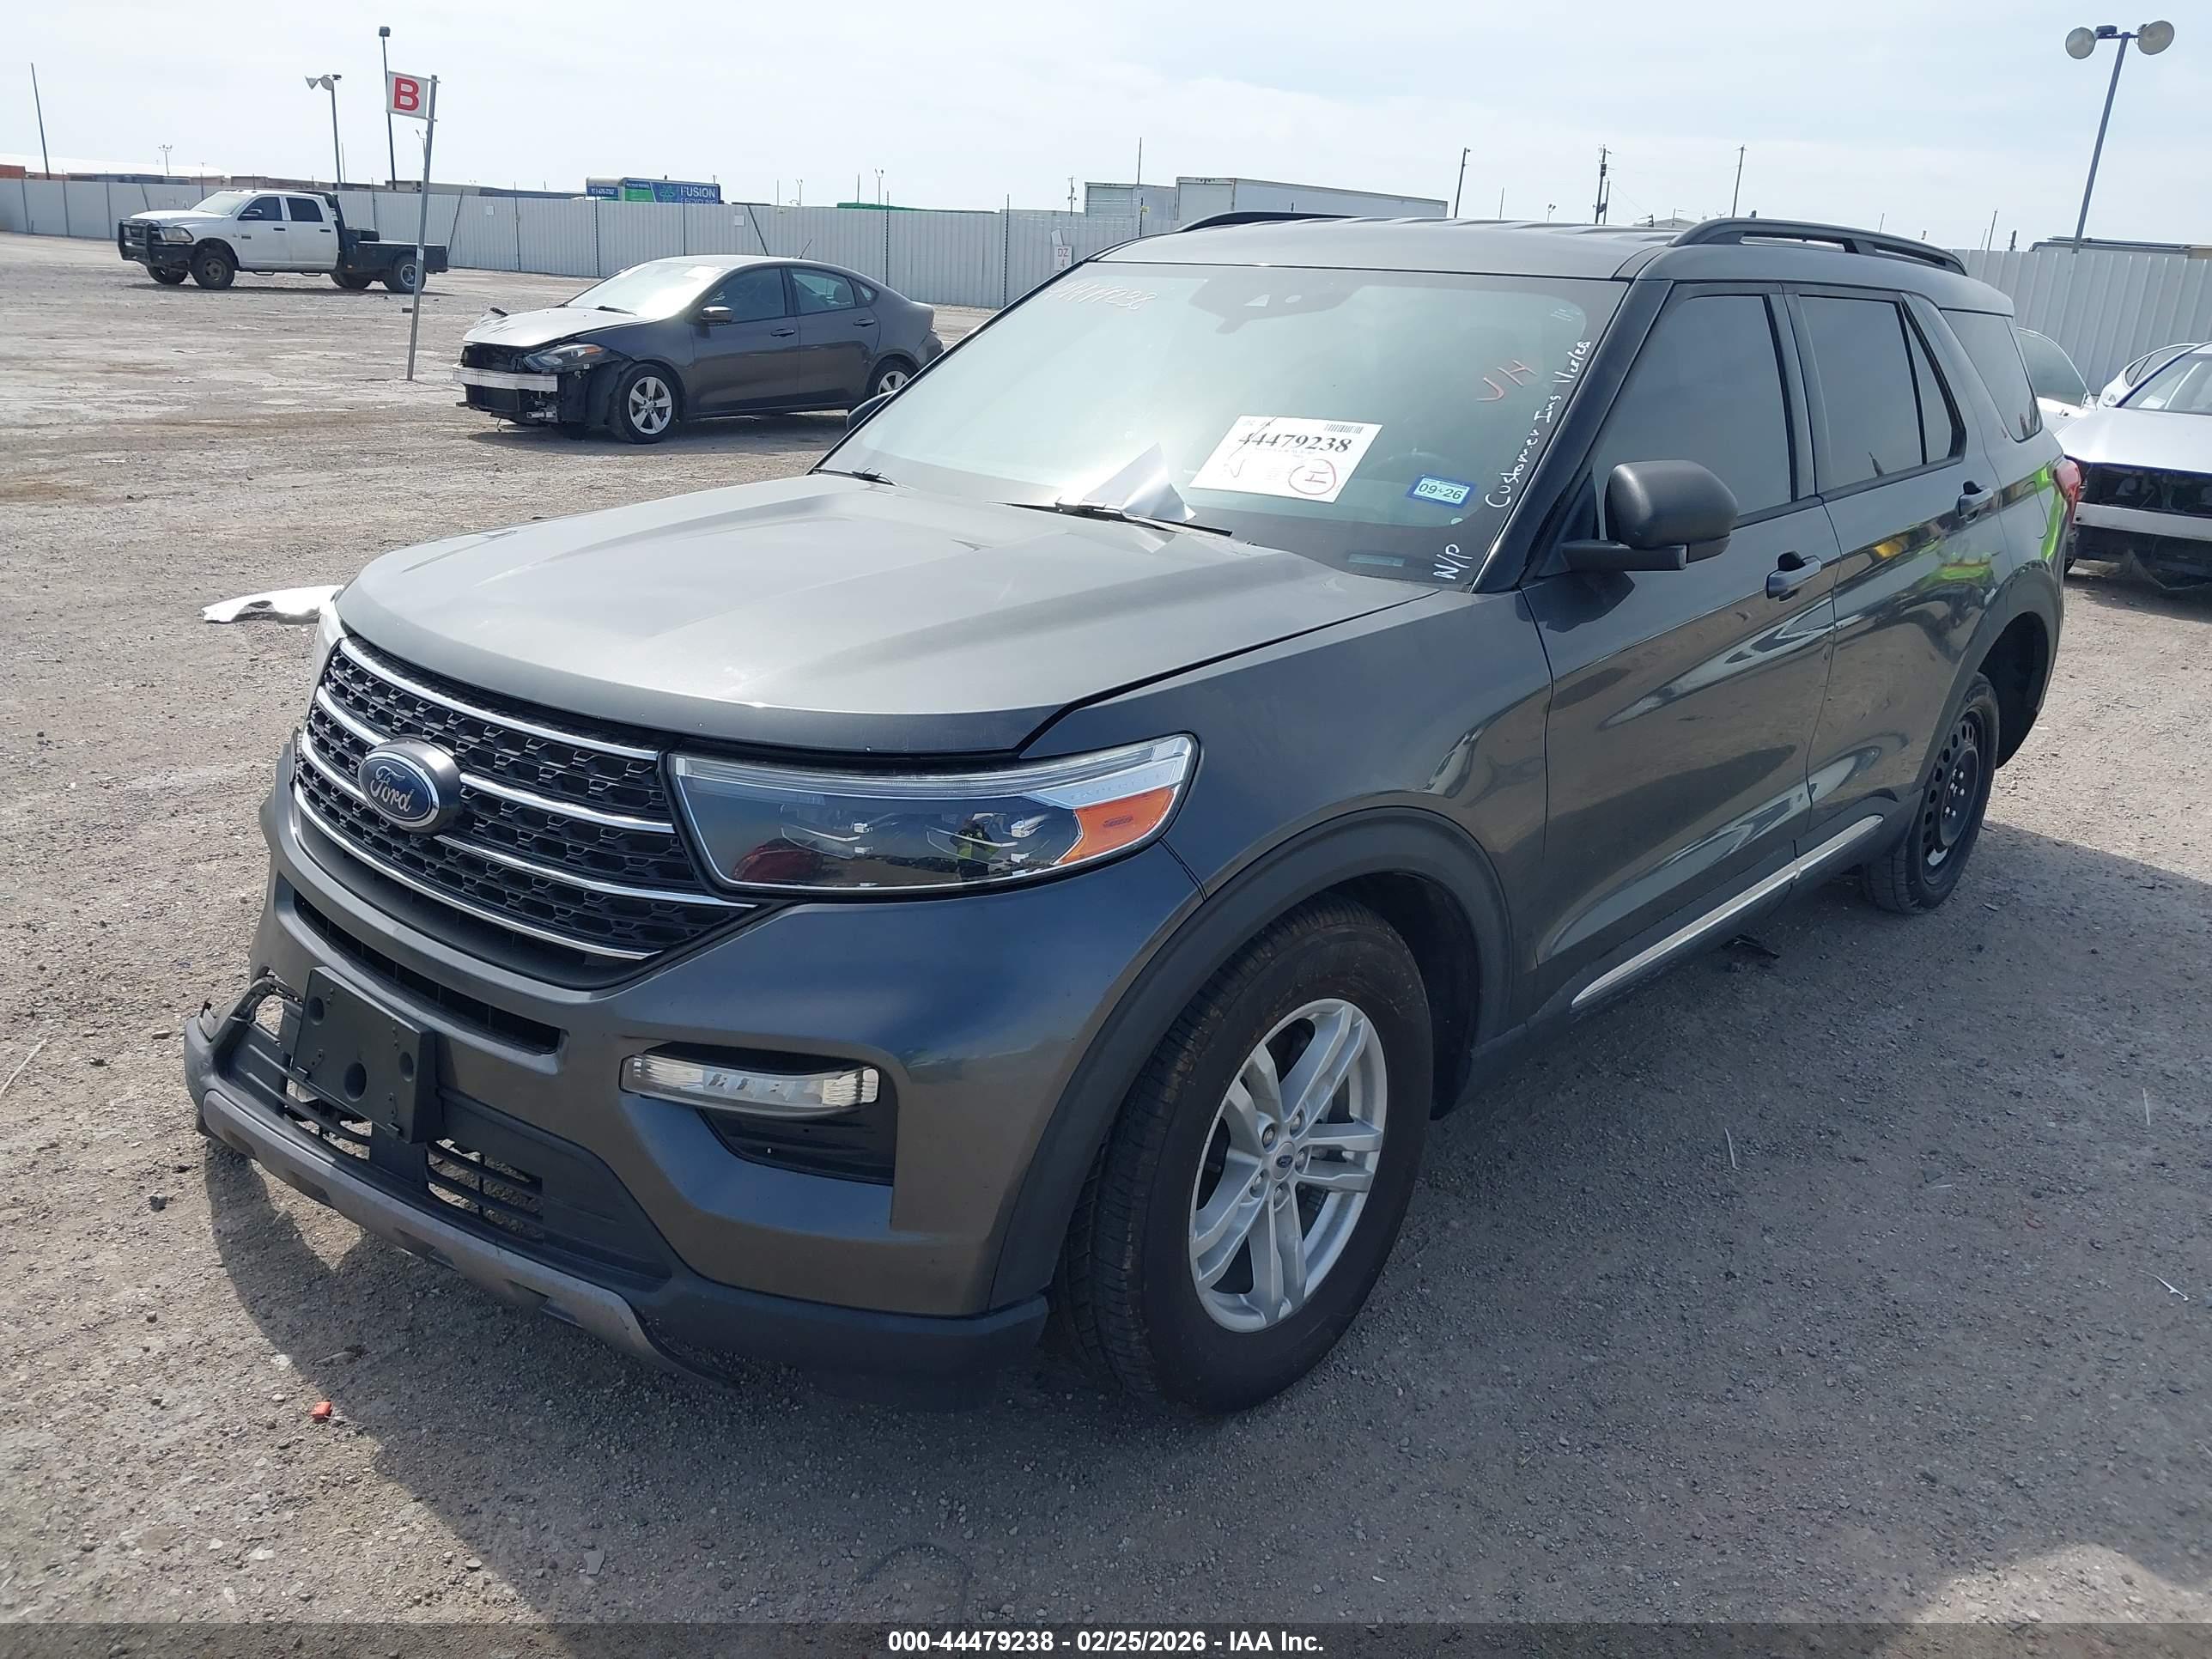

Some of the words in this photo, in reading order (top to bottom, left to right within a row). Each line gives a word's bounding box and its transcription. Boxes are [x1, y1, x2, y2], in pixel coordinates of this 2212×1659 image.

[394, 77, 419, 111] B
[680, 185, 715, 198] FUSION
[1238, 432, 1352, 453] 44479238
[1432, 543, 1474, 580] N/P
[370, 765, 416, 812] Ford
